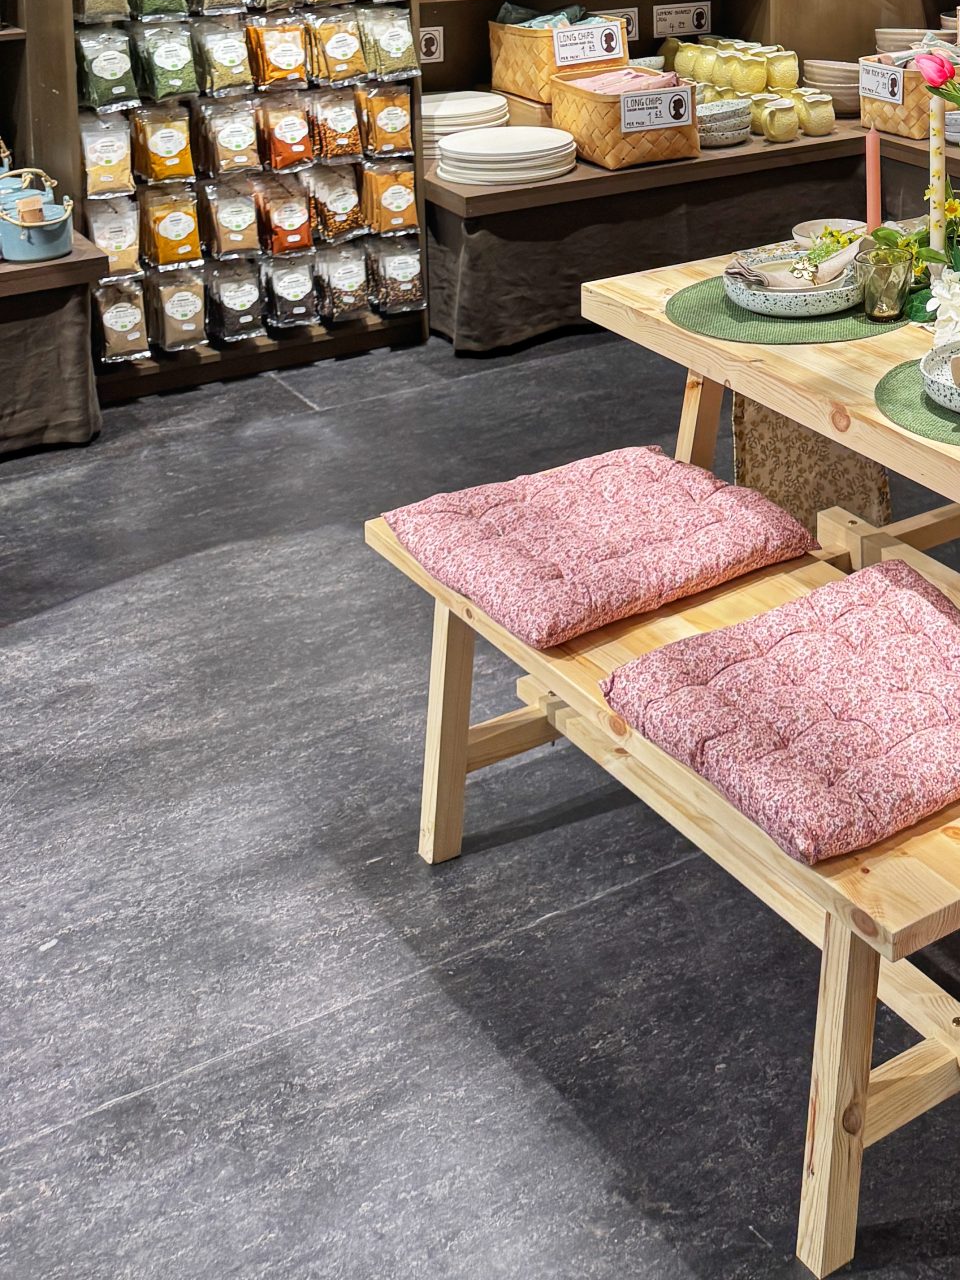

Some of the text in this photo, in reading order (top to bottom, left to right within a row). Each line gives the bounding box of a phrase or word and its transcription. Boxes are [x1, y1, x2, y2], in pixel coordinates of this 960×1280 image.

[560, 31, 594, 43] LONG CHIPS
[626, 97, 645, 109] LONG
[645, 96, 663, 107] CHIPS
